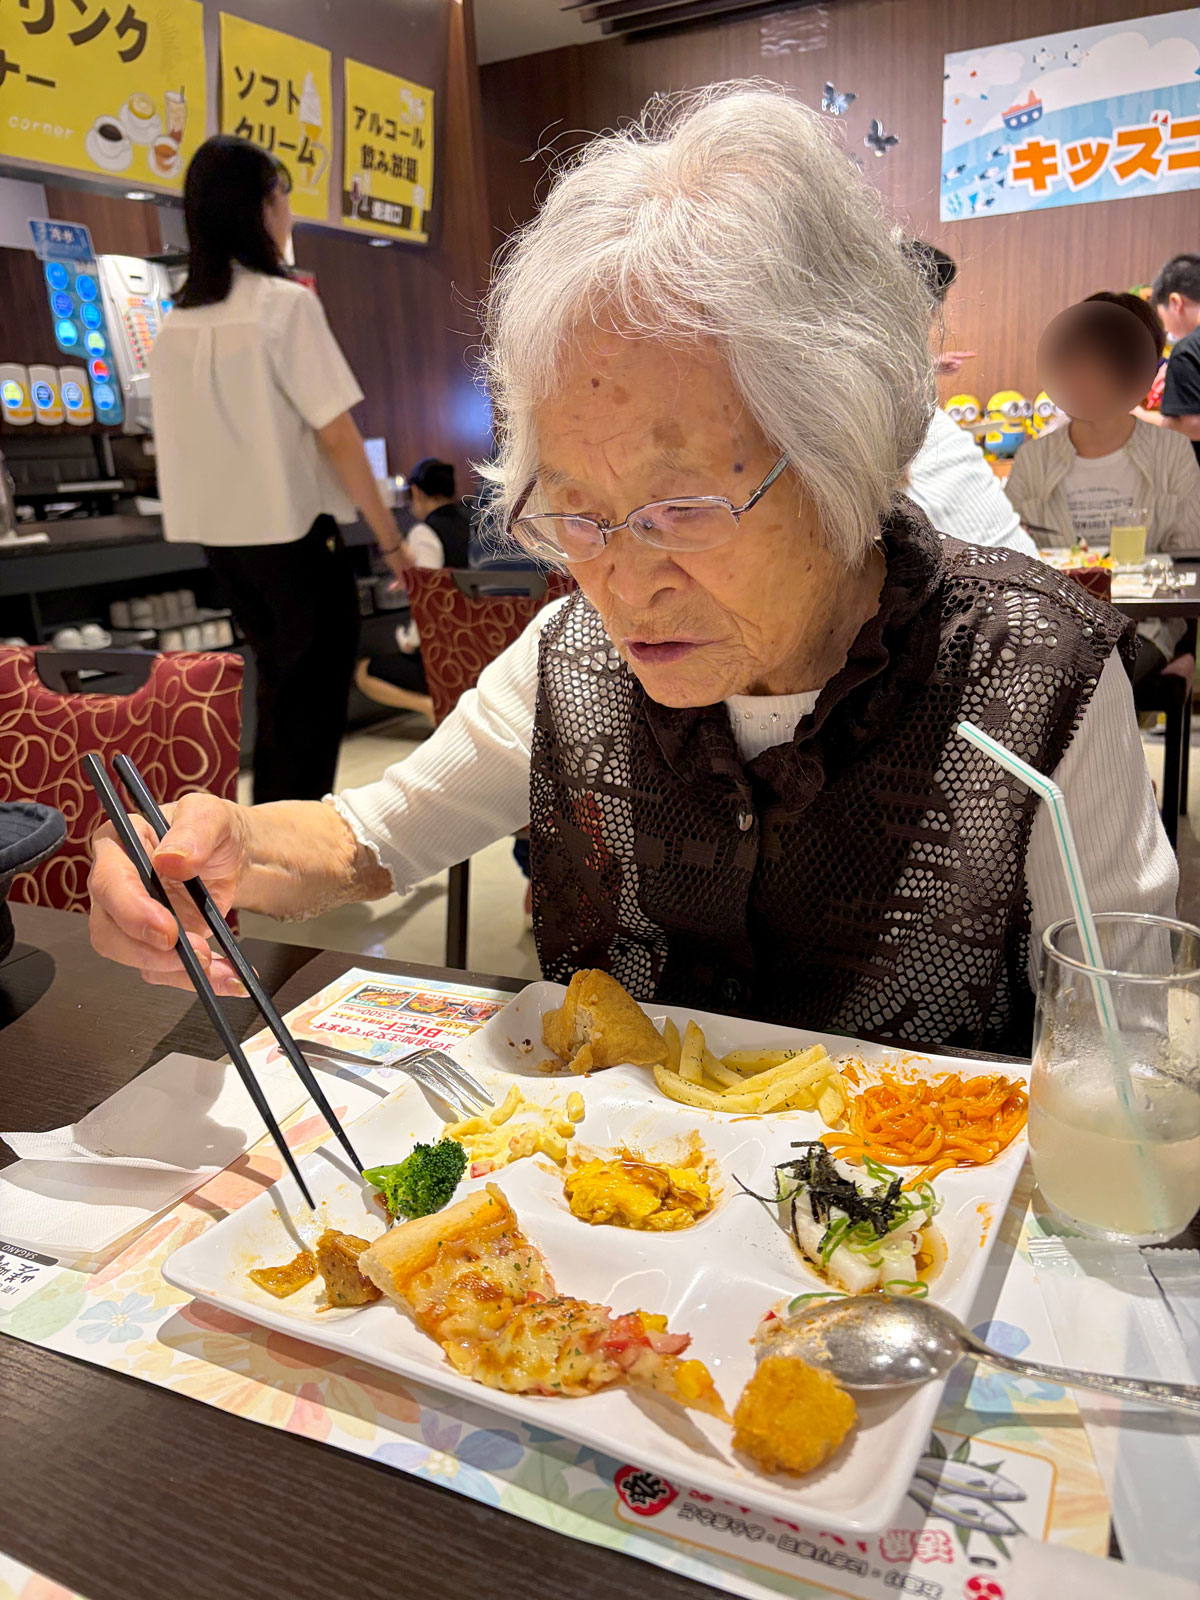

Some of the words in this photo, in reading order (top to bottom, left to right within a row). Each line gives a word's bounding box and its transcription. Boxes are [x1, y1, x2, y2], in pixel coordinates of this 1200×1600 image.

[234, 65, 300, 115] ソフト
[8, 115, 74, 139] corner
[234, 116, 315, 167] クリーム
[352, 105, 425, 151] アルコール
[361, 143, 418, 184] 飲み放題
[1, 1244, 39, 1260] SAGANO
